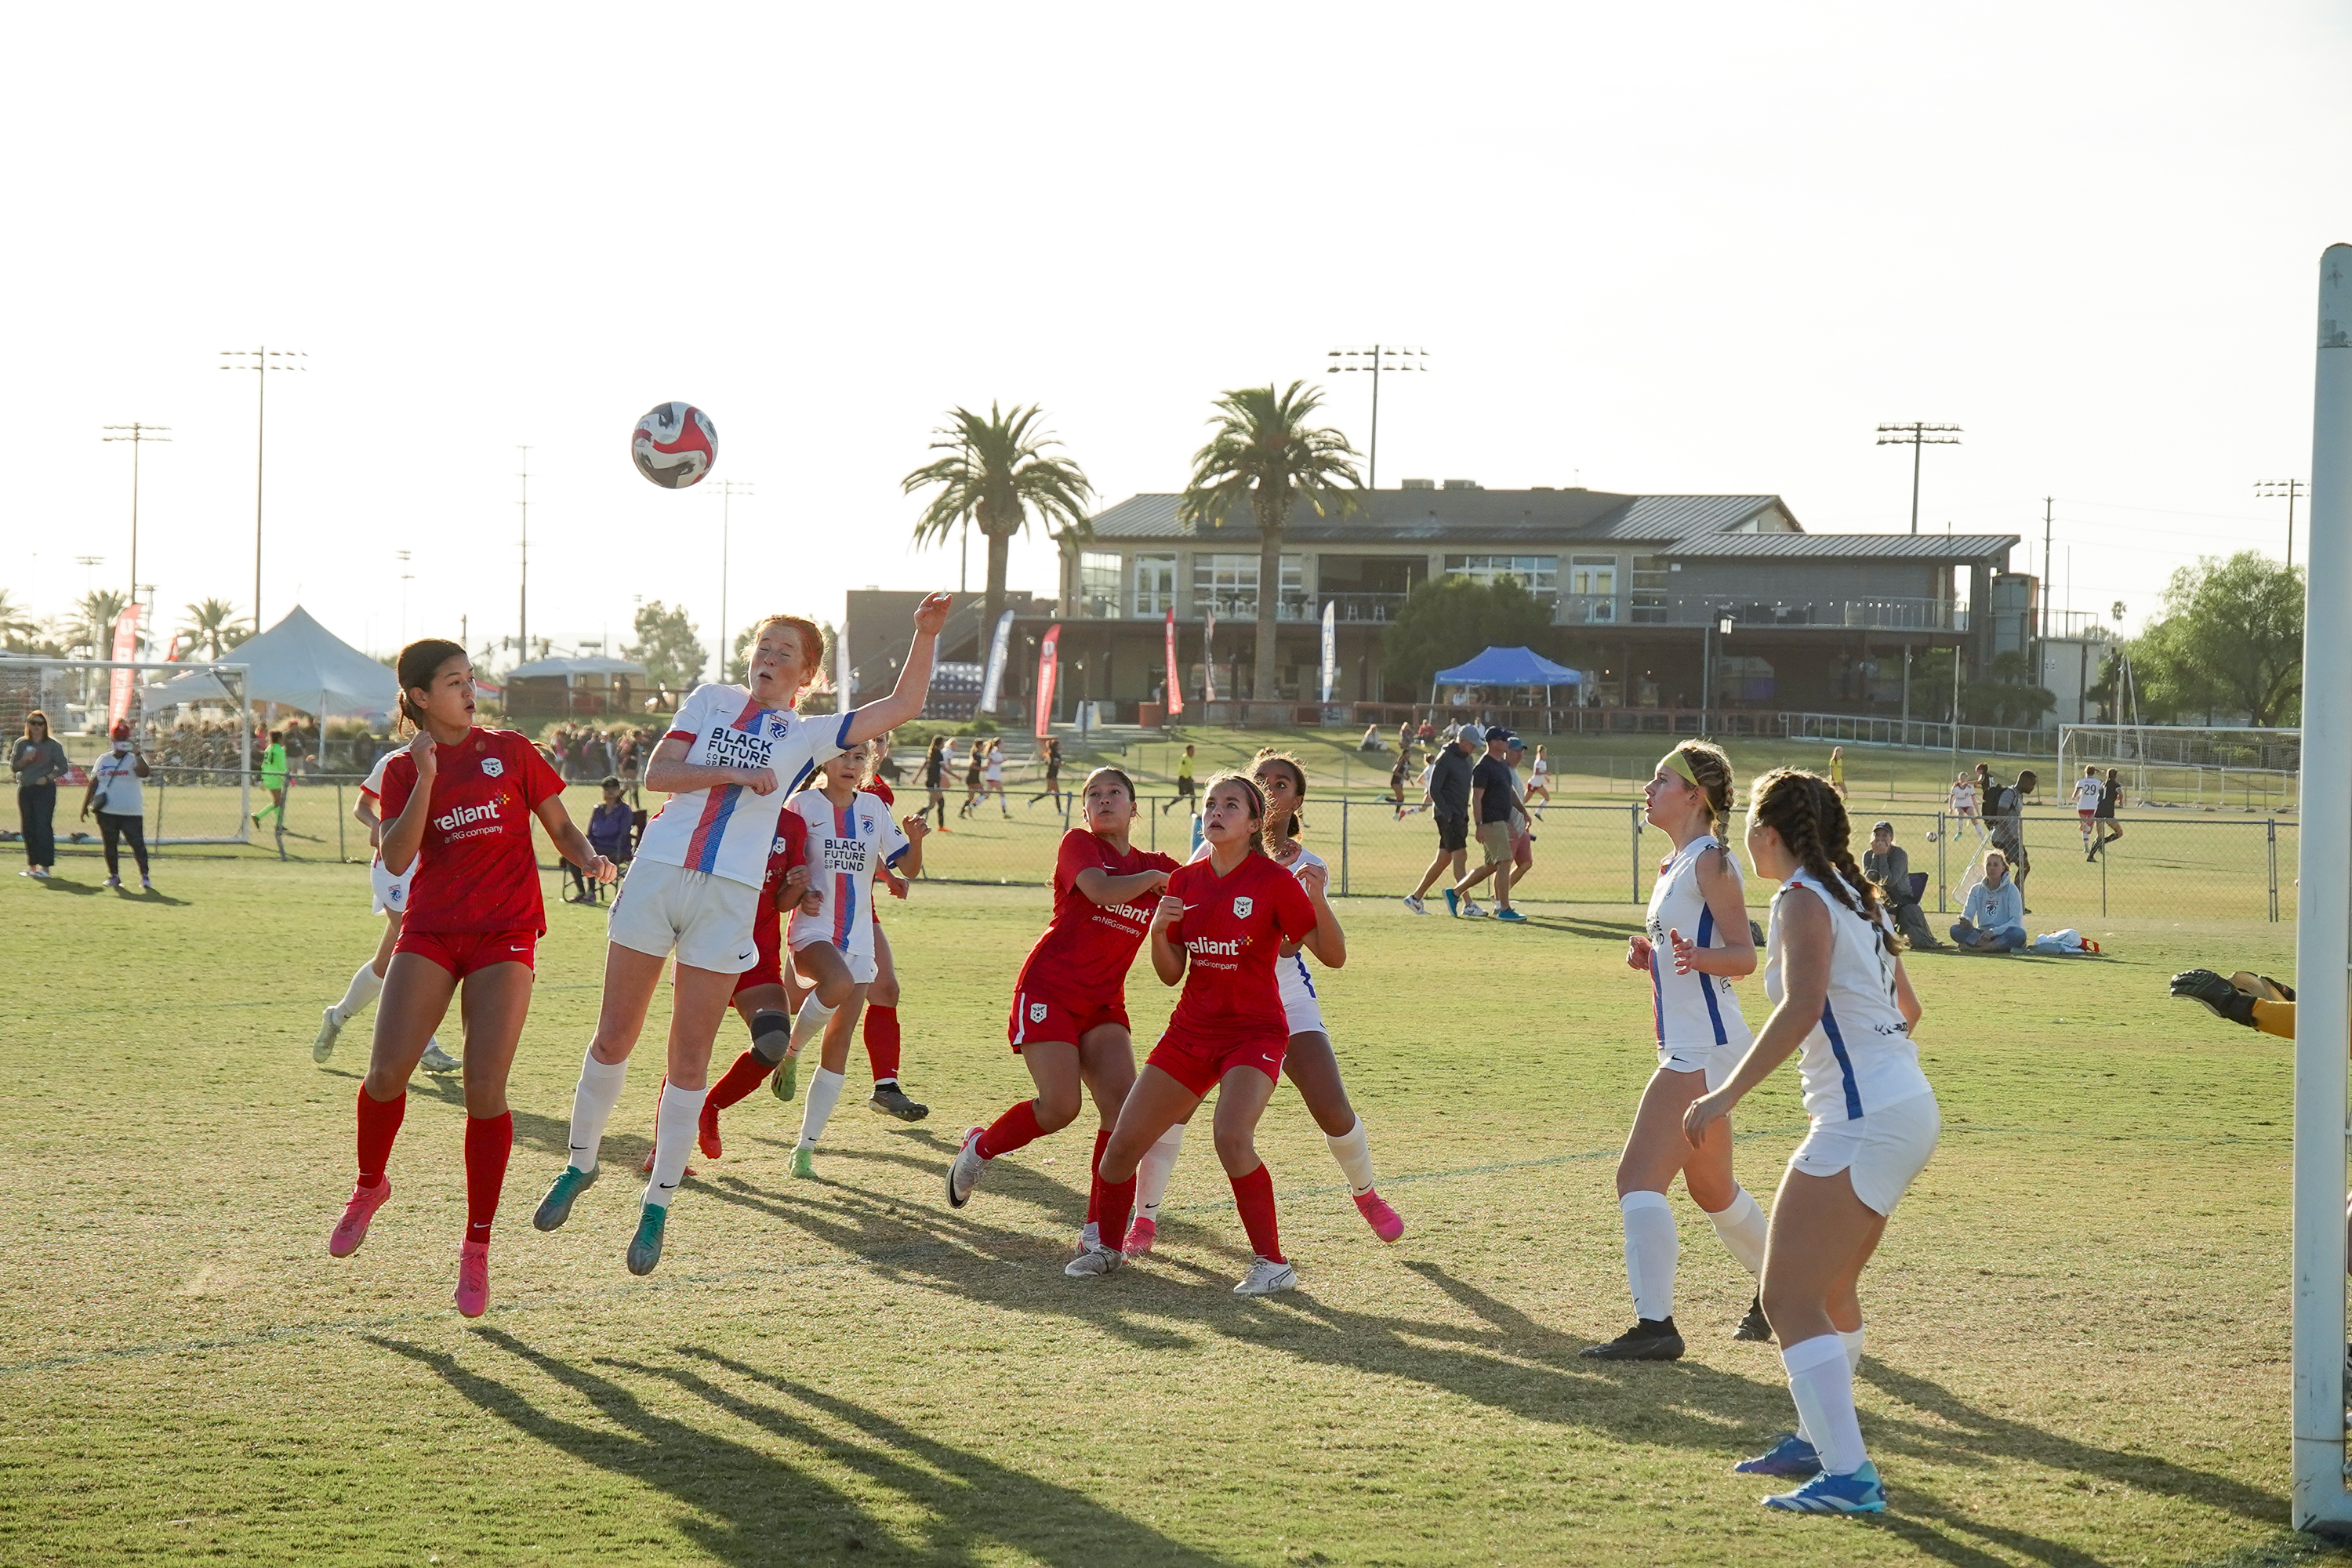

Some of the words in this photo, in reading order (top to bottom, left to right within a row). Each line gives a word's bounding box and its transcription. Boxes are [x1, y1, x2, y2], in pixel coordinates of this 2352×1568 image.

[711, 728, 773, 754] BLACK
[708, 740, 771, 766] FUTURE
[2084, 784, 2096, 796] 29
[434, 800, 500, 832] reliant
[451, 831, 466, 841] RG
[466, 826, 503, 837] company
[825, 839, 866, 852] BLACK
[825, 850, 866, 862] FUTURE
[834, 860, 864, 871] FUND
[1102, 916, 1117, 927] NRG
[1116, 924, 1142, 938] company
[1184, 936, 1240, 956] reliant
